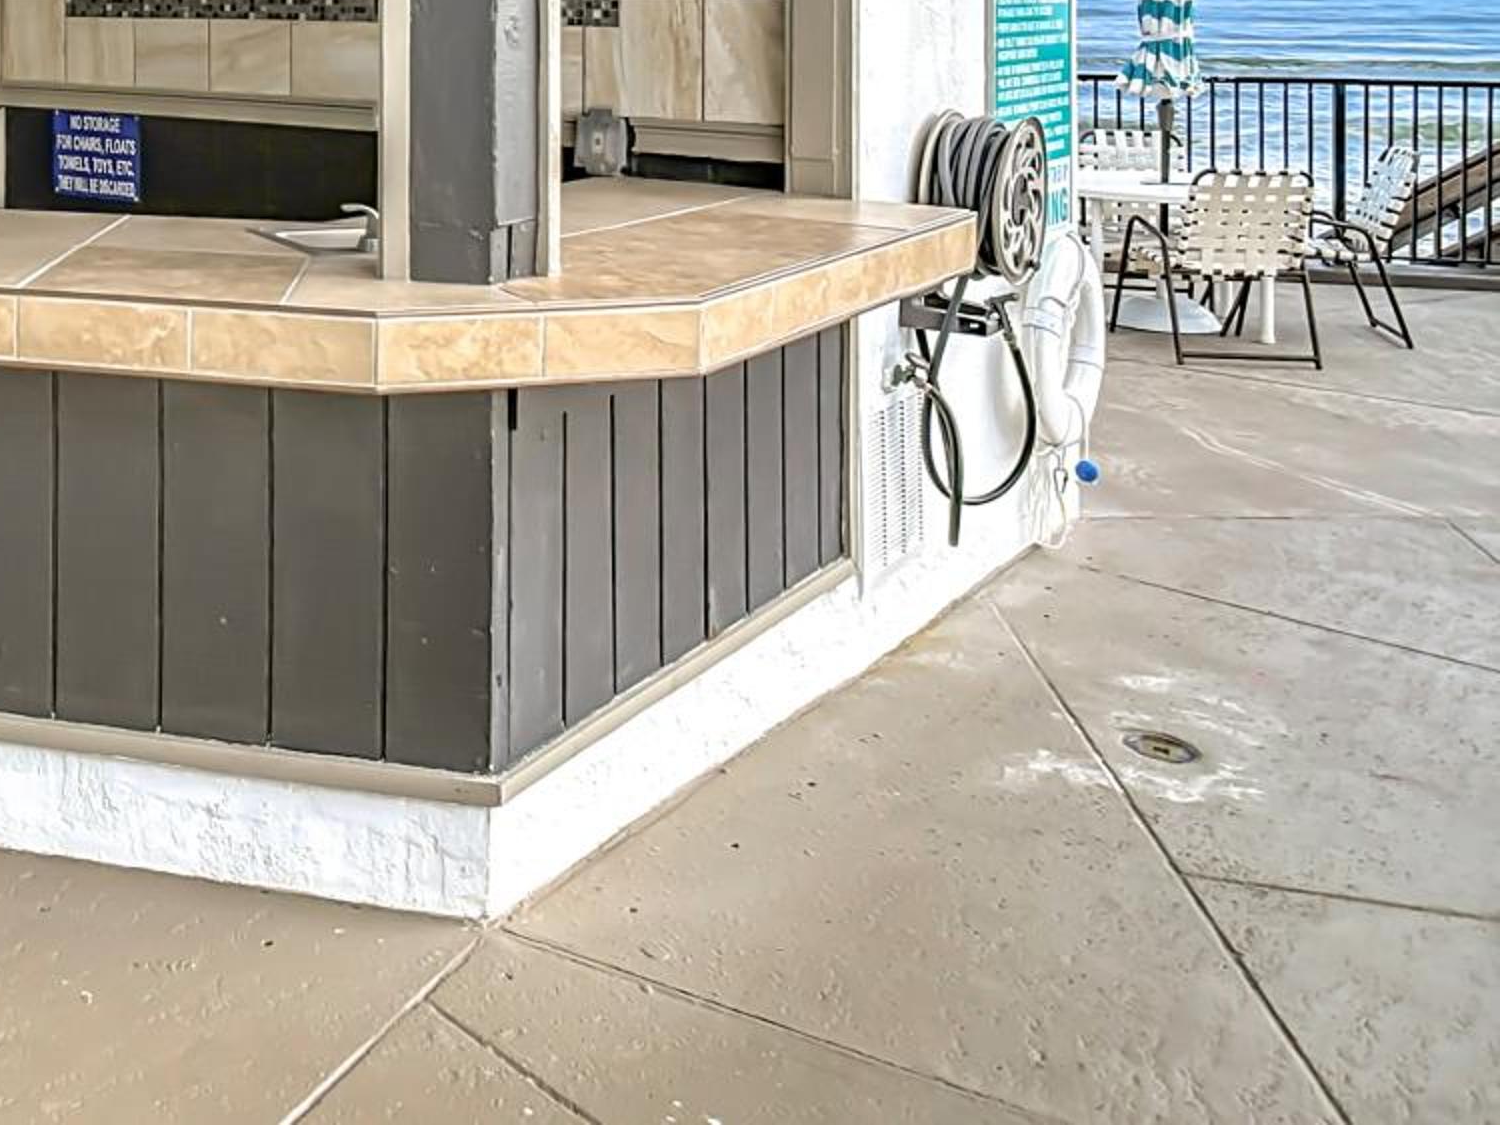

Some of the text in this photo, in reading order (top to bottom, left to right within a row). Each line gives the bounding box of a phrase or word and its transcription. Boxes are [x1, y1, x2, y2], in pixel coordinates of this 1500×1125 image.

[69, 115, 120, 133] NO STORAGE
[56, 134, 72, 150] FOR
[89, 178, 99, 193] BE
